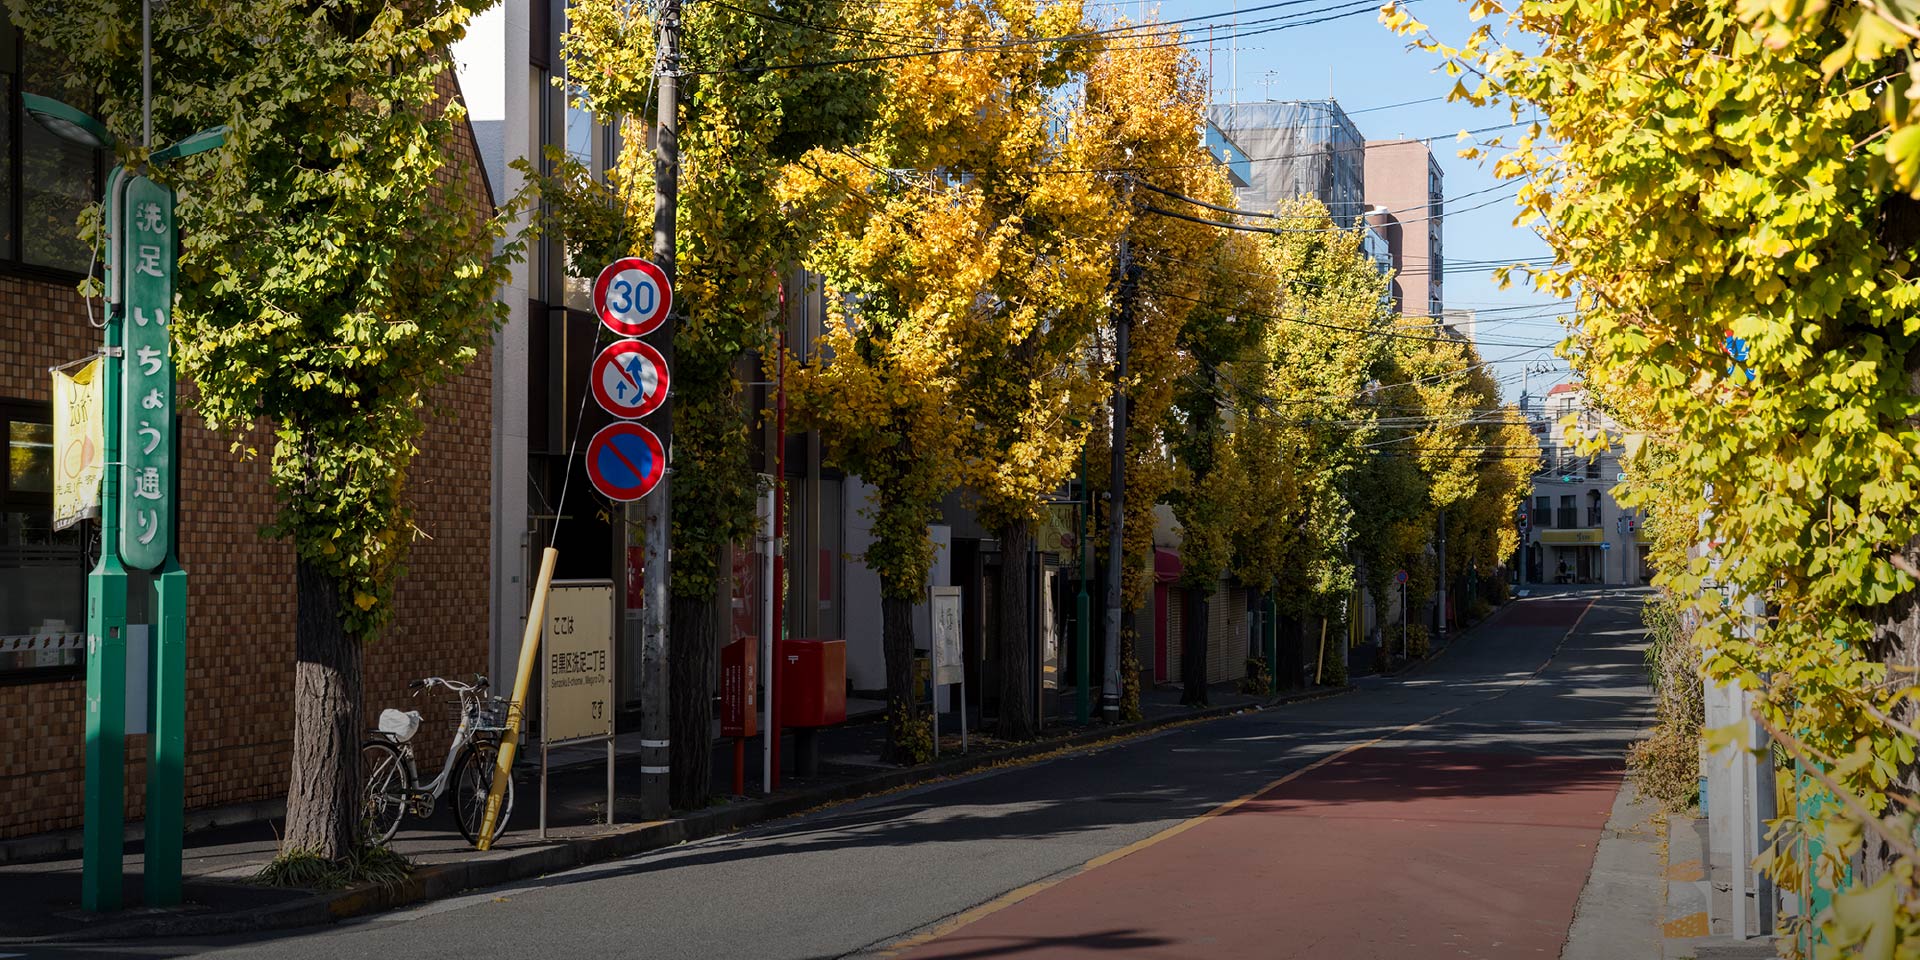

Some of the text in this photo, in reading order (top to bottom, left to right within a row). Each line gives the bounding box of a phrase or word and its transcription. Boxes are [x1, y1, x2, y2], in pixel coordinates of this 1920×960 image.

[613, 280, 654, 314] 30
[133, 202, 168, 546] 洗足いちょう通り
[554, 616, 574, 635] ここは
[551, 650, 606, 674] 目黒区洗足二丁目
[592, 699, 604, 719] です
